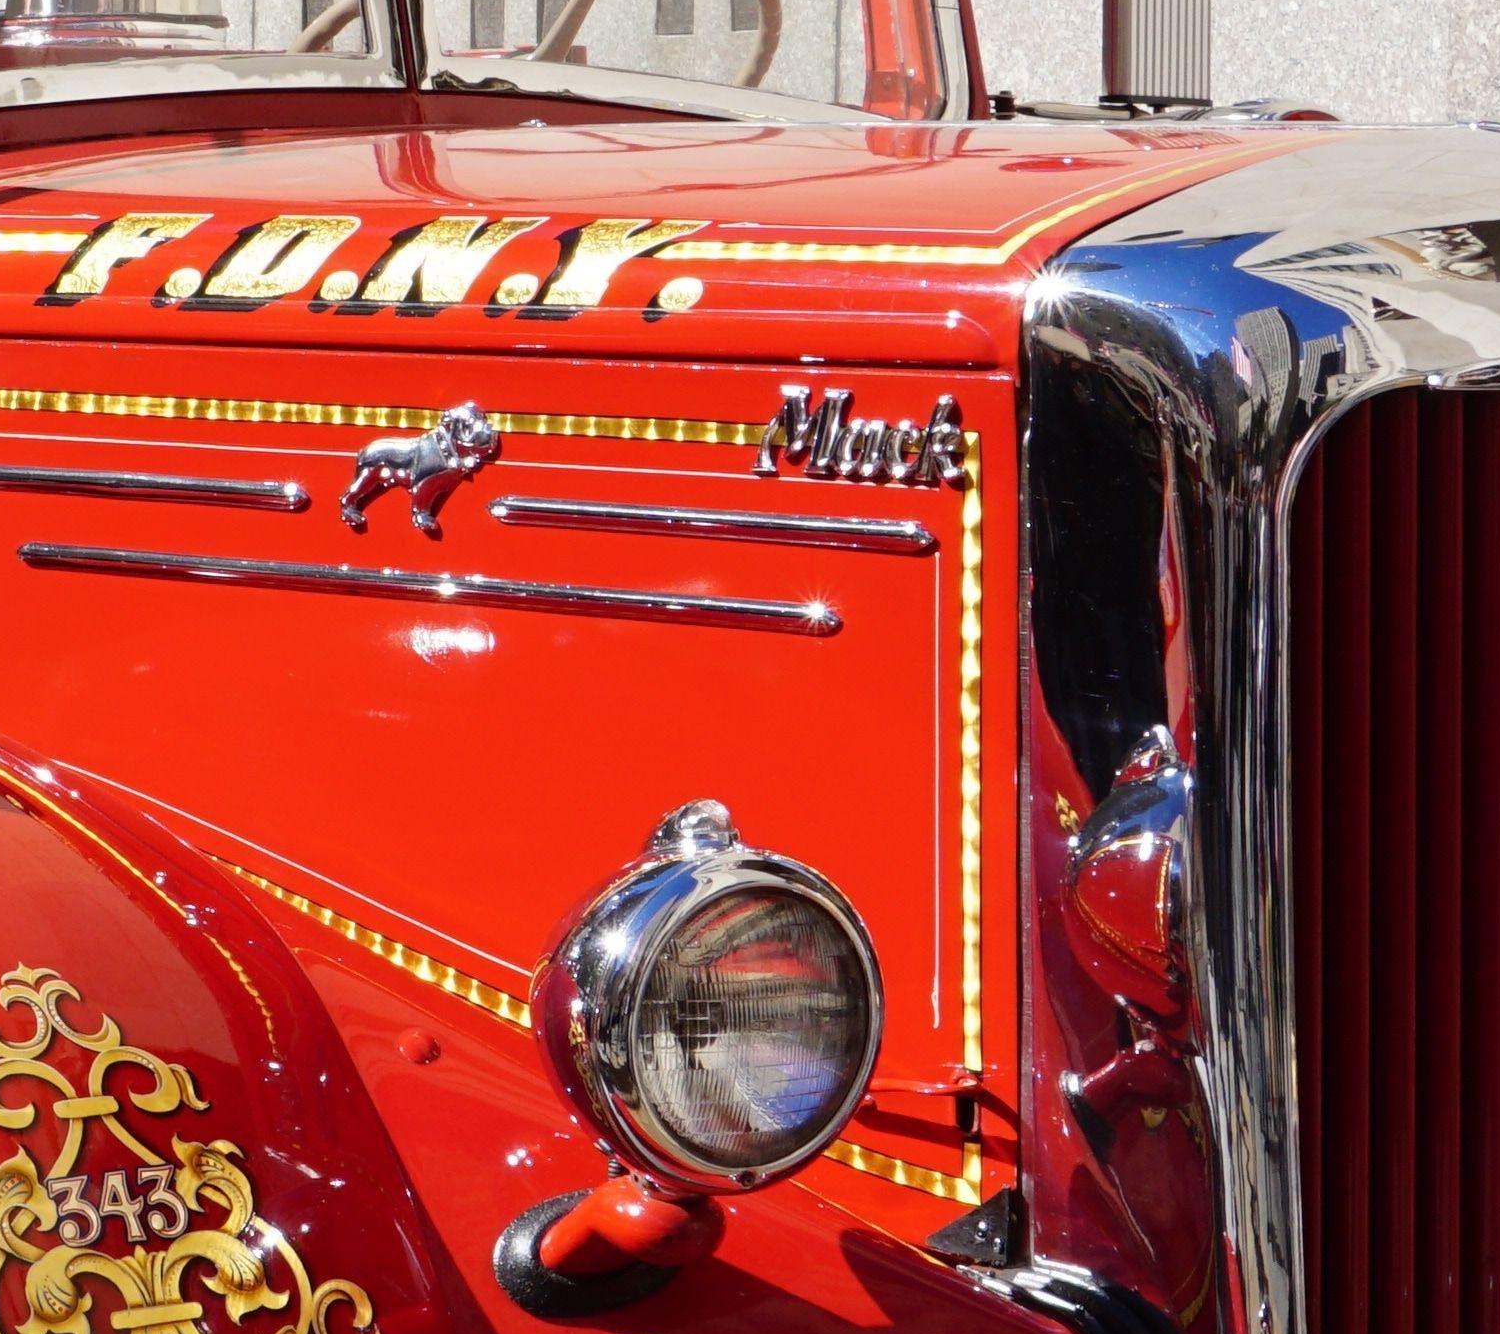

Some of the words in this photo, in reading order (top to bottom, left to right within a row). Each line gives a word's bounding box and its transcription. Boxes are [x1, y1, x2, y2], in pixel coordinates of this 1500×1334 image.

[56, 212, 711, 314] F.D.N.Y.
[751, 383, 966, 482] Mack
[47, 1163, 189, 1248] 343
